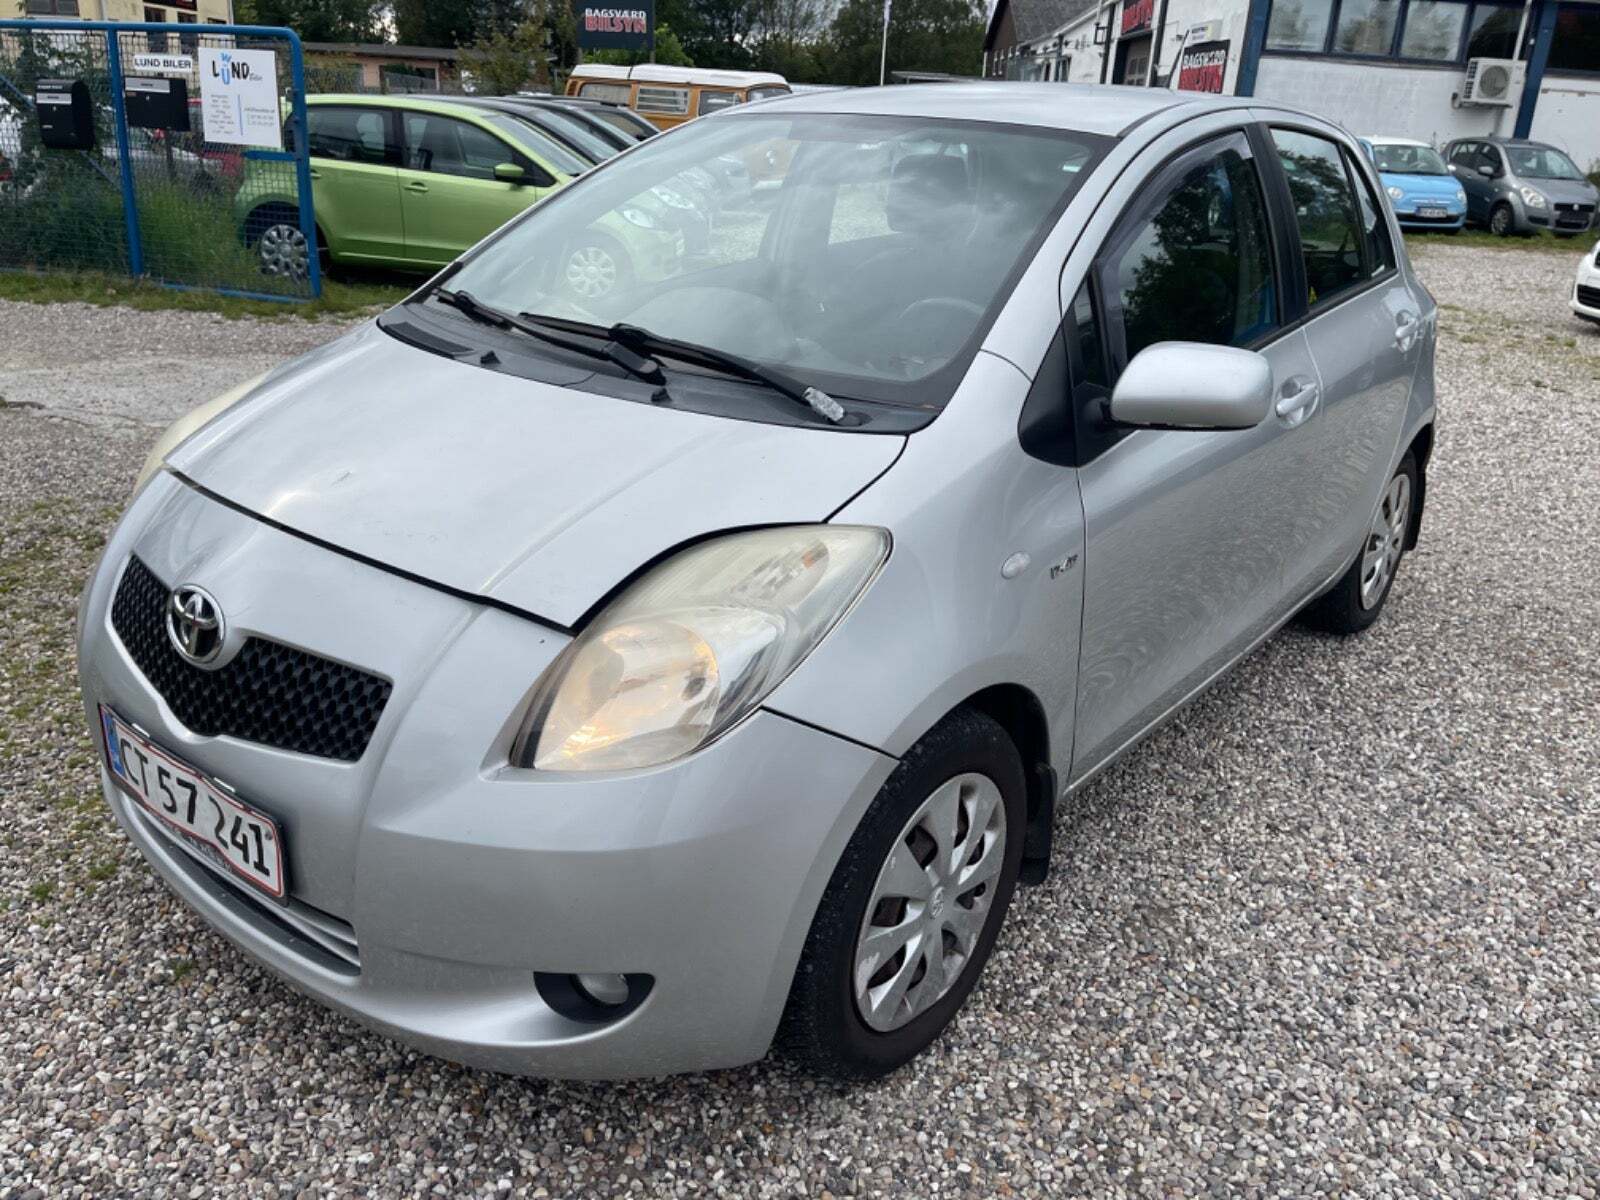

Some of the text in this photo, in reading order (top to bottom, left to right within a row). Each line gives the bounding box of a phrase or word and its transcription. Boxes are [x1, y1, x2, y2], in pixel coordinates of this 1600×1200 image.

[585, 8, 646, 19] BAGSVÆRD
[585, 16, 647, 33] BILSYN
[135, 57, 192, 70] LUND BILER
[120, 738, 149, 797] CT
[157, 766, 198, 825] 57
[208, 795, 270, 877] 241
